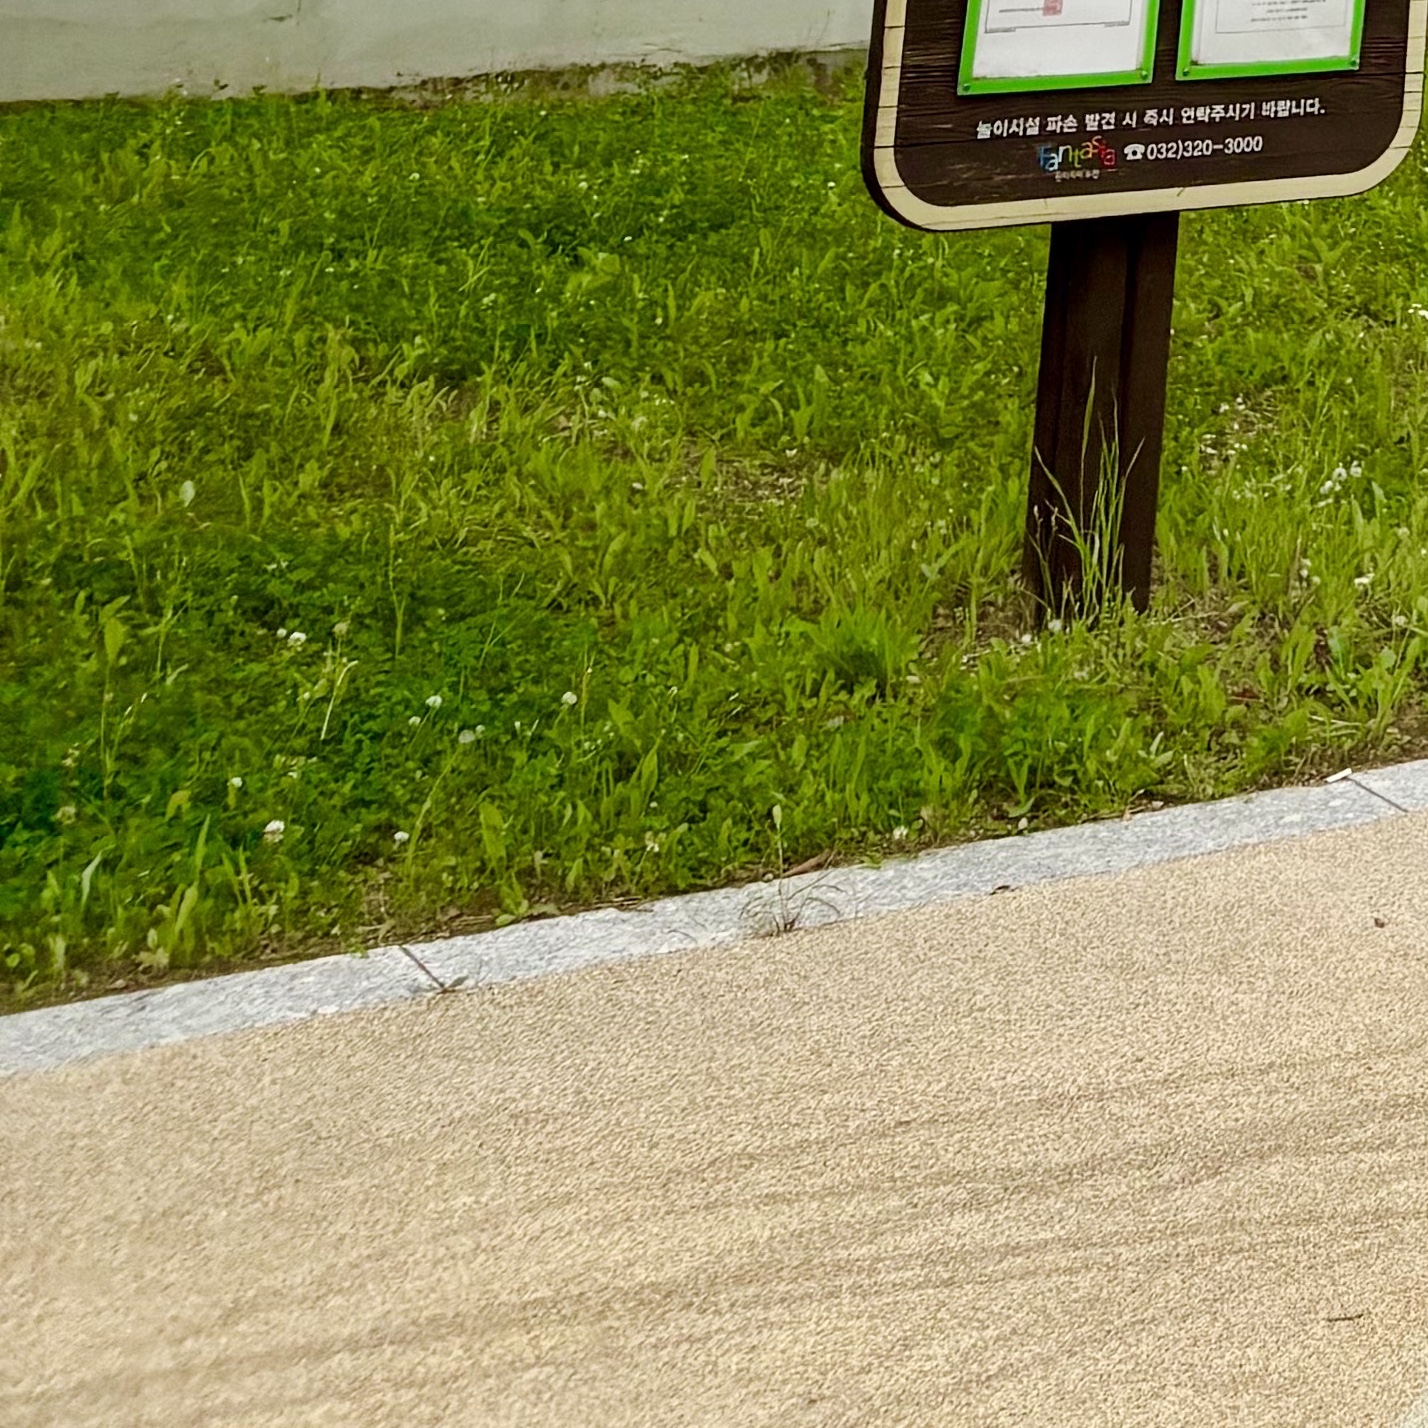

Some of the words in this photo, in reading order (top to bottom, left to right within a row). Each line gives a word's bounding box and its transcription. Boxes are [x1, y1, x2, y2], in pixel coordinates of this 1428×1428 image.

[976, 116, 1040, 140] 놀이시설
[1046, 115, 1079, 134] 파손
[1084, 111, 1116, 131] 발견
[1122, 110, 1139, 128] 시
[1143, 108, 1174, 127] 즉시
[1181, 103, 1255, 125] 연락주시기
[1262, 98, 1326, 119] 바랍니다.
[1146, 136, 1264, 161] 032)320-3000
